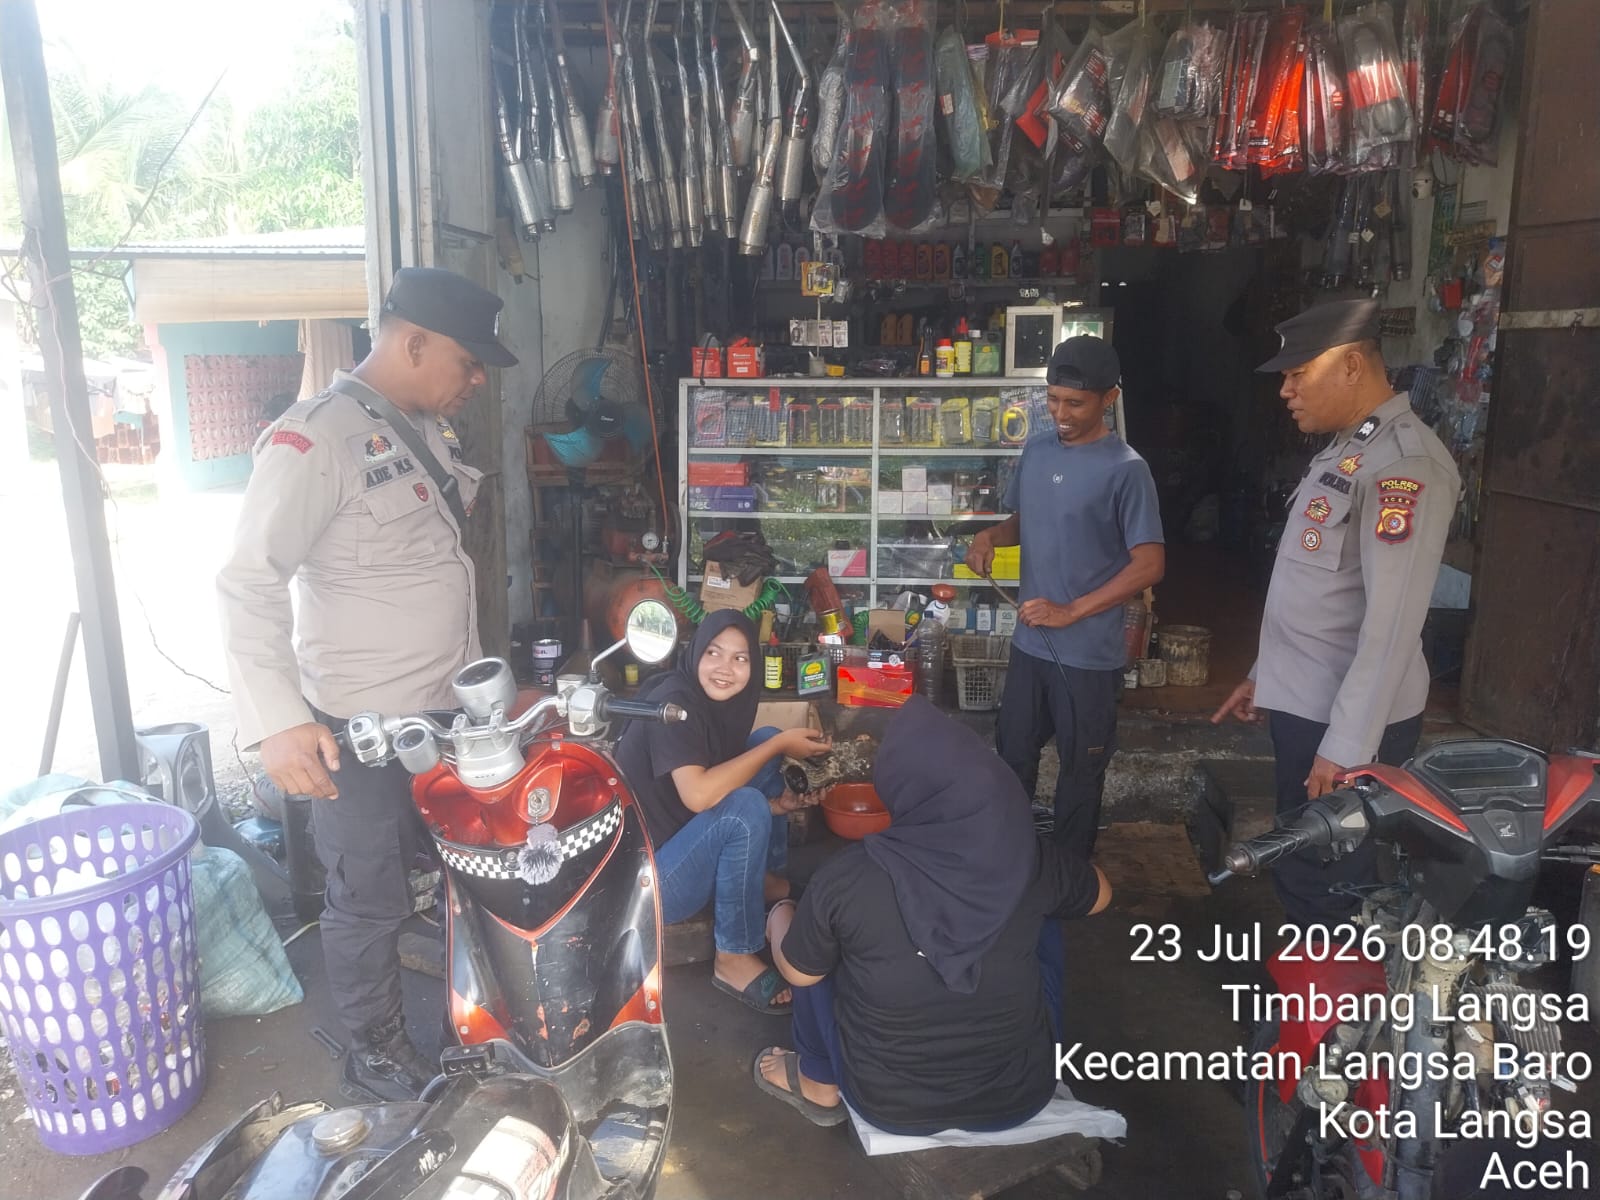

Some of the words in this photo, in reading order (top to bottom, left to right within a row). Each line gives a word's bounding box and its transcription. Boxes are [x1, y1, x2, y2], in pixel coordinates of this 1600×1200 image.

[366, 465, 393, 489] ADE
[1381, 479, 1419, 491] POLRES
[1384, 497, 1411, 505] ACEH
